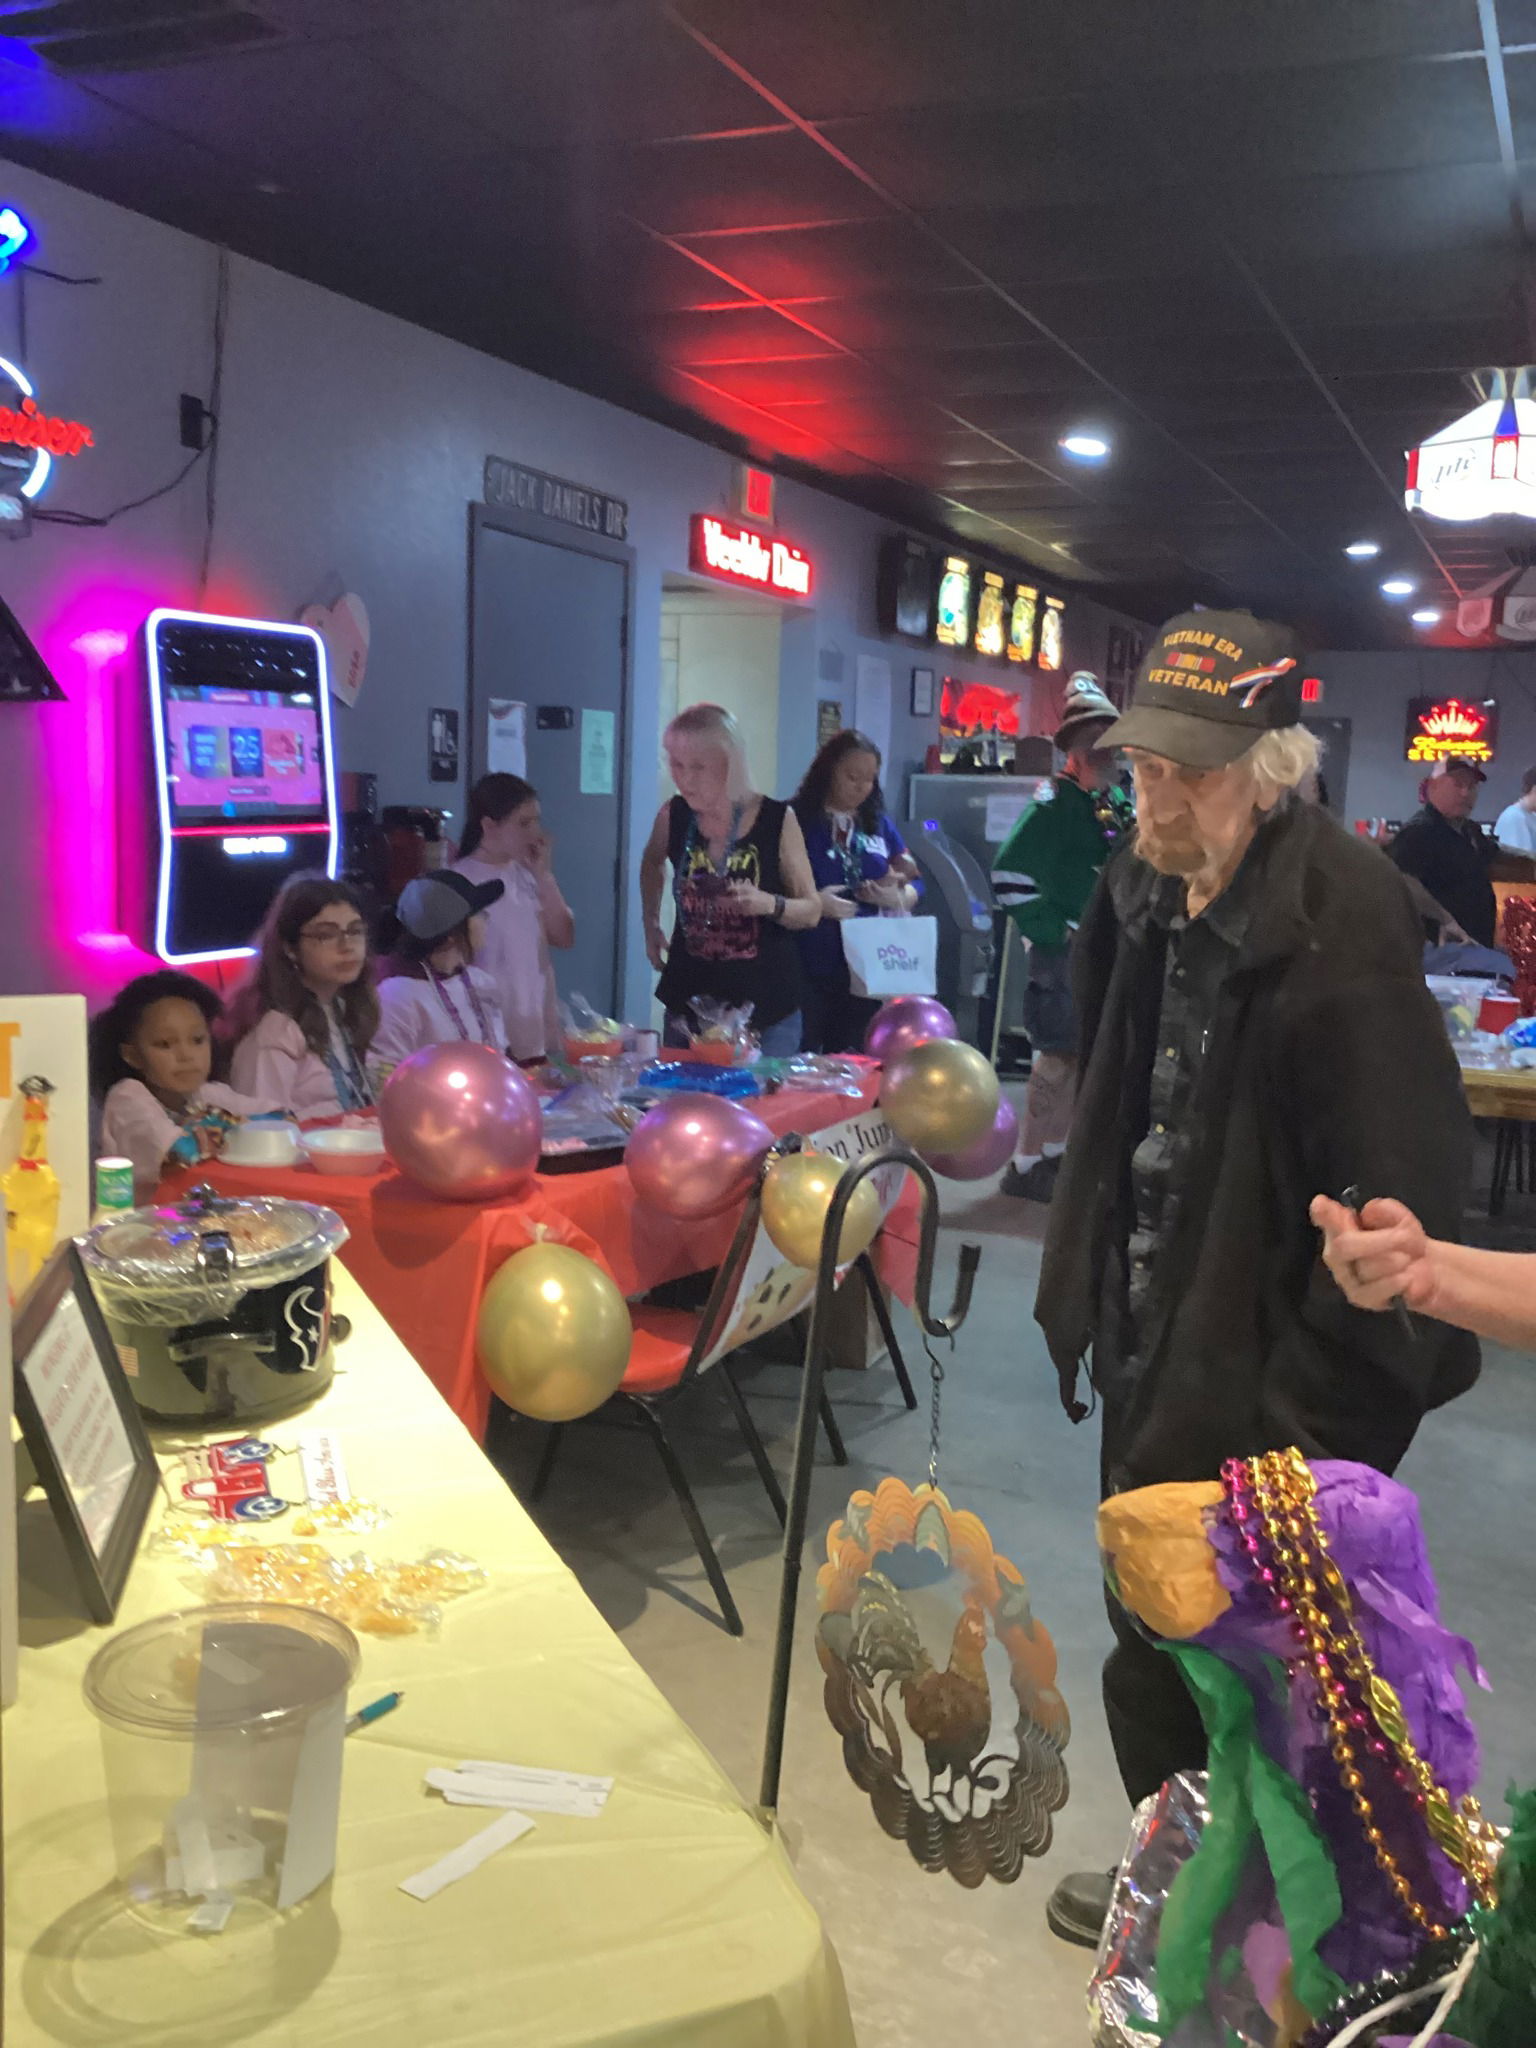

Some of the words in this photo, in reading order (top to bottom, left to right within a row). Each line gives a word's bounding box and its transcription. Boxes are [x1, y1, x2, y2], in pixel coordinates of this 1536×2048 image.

[496, 465, 537, 511] JACK
[543, 480, 601, 530] DANIELS
[606, 500, 624, 534] DR
[1164, 630, 1216, 648] VIETNAM
[1214, 638, 1243, 662] ERA
[1148, 668, 1228, 696] VETERAN
[877, 944, 907, 960] pop
[882, 957, 919, 971] shelf
